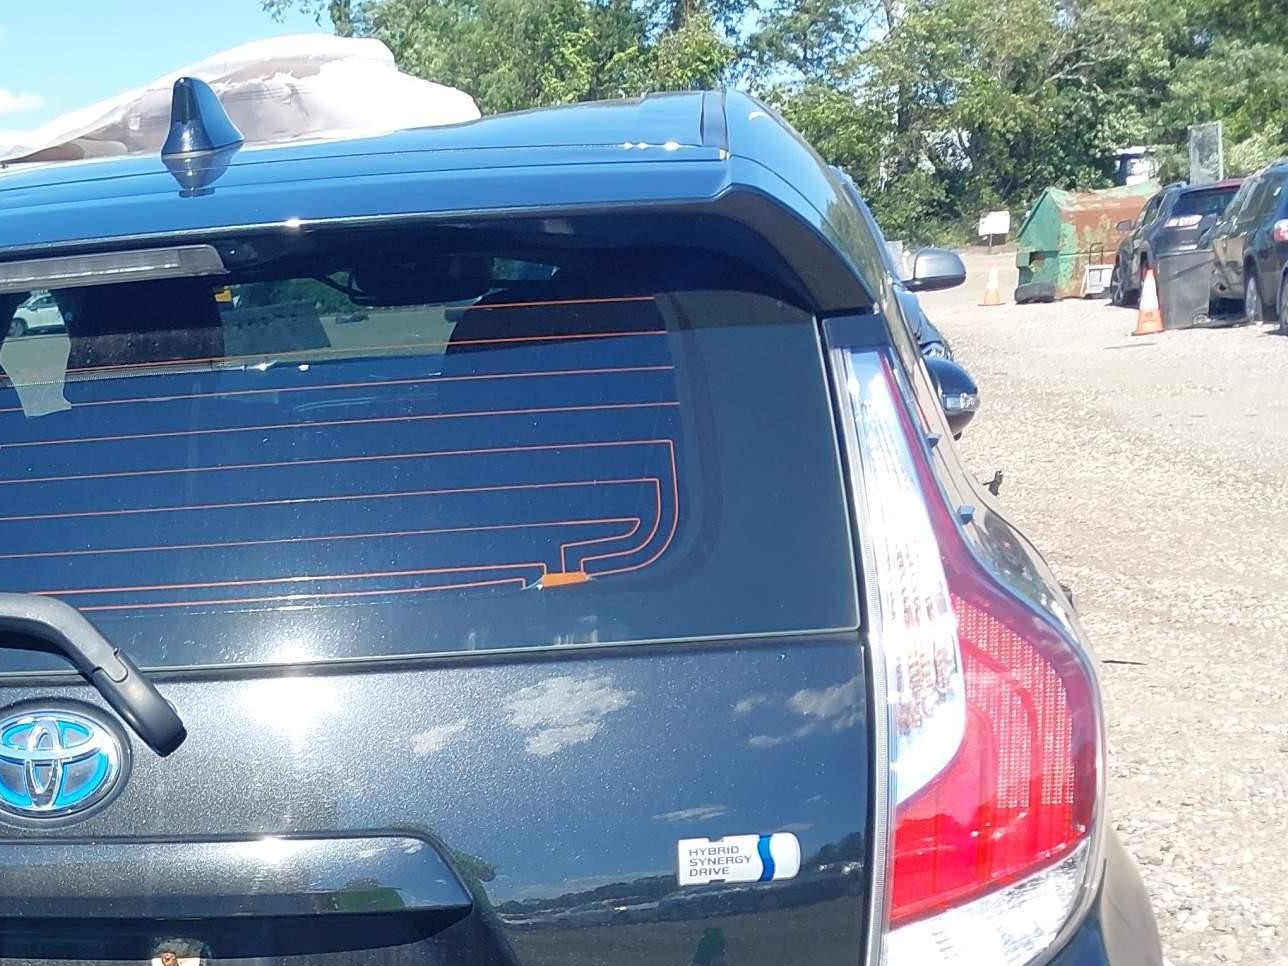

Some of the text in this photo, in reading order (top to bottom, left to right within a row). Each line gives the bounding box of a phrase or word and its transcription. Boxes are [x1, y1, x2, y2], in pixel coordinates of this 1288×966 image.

[689, 845, 739, 857] HYBRID
[689, 855, 753, 867] SYNERGY
[689, 866, 730, 877] DRIVE
